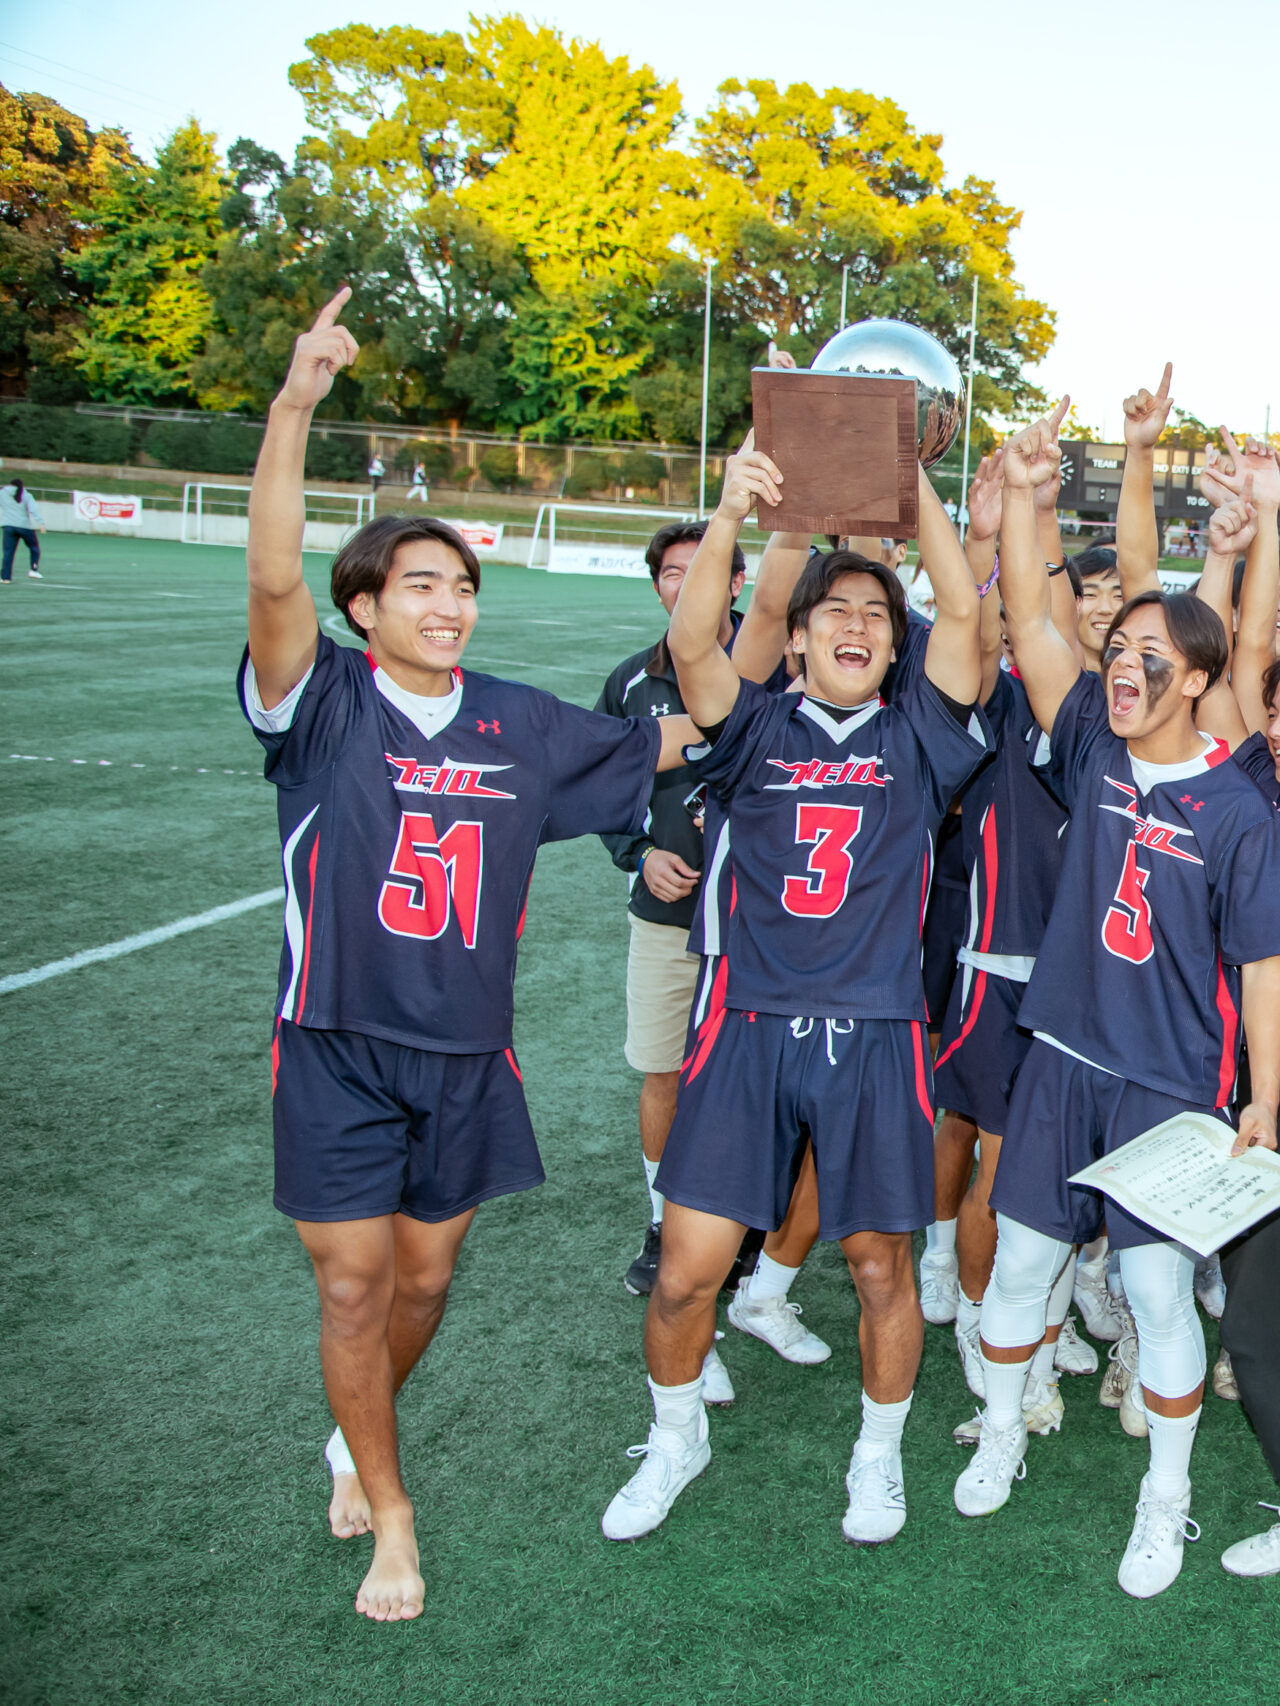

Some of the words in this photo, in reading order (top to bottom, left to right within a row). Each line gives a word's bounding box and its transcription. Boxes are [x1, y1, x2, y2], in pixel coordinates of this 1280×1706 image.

[1092, 459, 1118, 469] TEAM
[1186, 496, 1198, 505] TO
[766, 757, 894, 788] KEIO
[377, 810, 483, 949] 51
[781, 803, 863, 918] 3
[1101, 838, 1155, 965] 5
